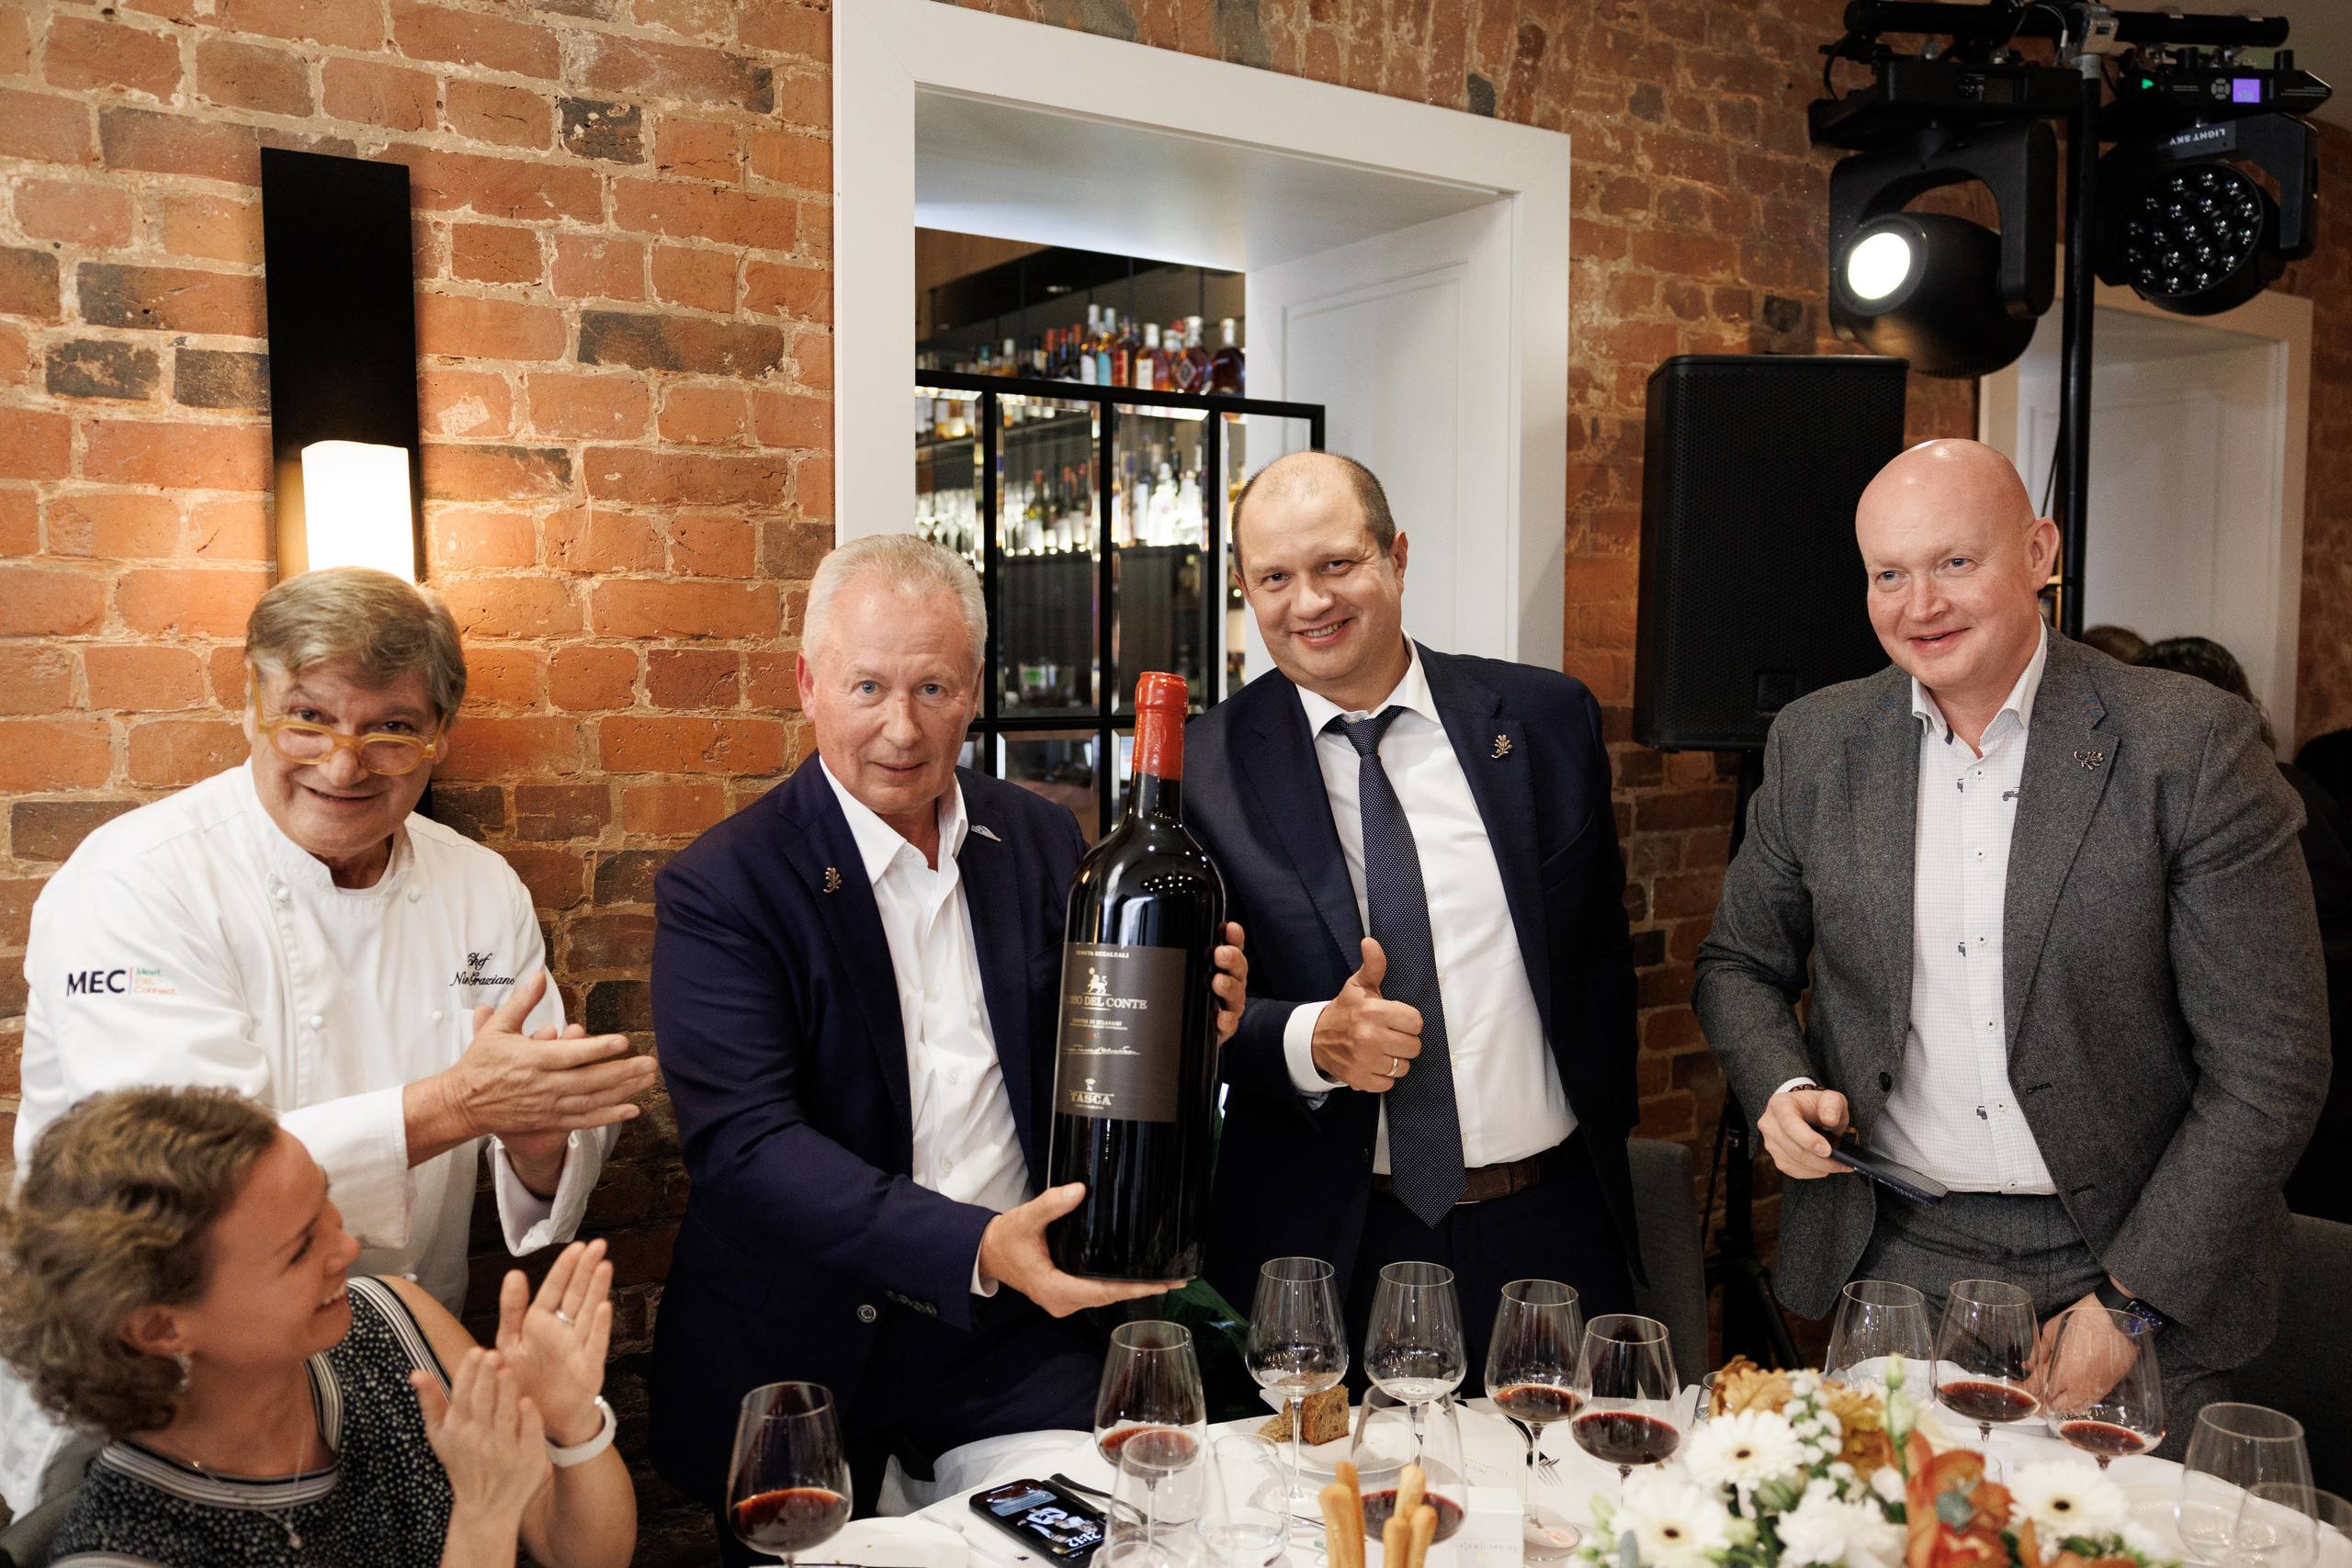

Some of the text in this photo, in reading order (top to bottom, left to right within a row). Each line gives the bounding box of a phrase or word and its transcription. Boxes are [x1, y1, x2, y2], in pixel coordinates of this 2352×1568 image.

[2168, 128, 2226, 146] LIGHT SKY
[66, 969, 127, 998] MEC
[449, 971, 470, 987] Nin
[1084, 996, 1105, 1007] DEL
[1105, 997, 1148, 1010] CONTE
[1070, 1093, 1112, 1106] TASCA
[1064, 1531, 1102, 1548] 21:12
